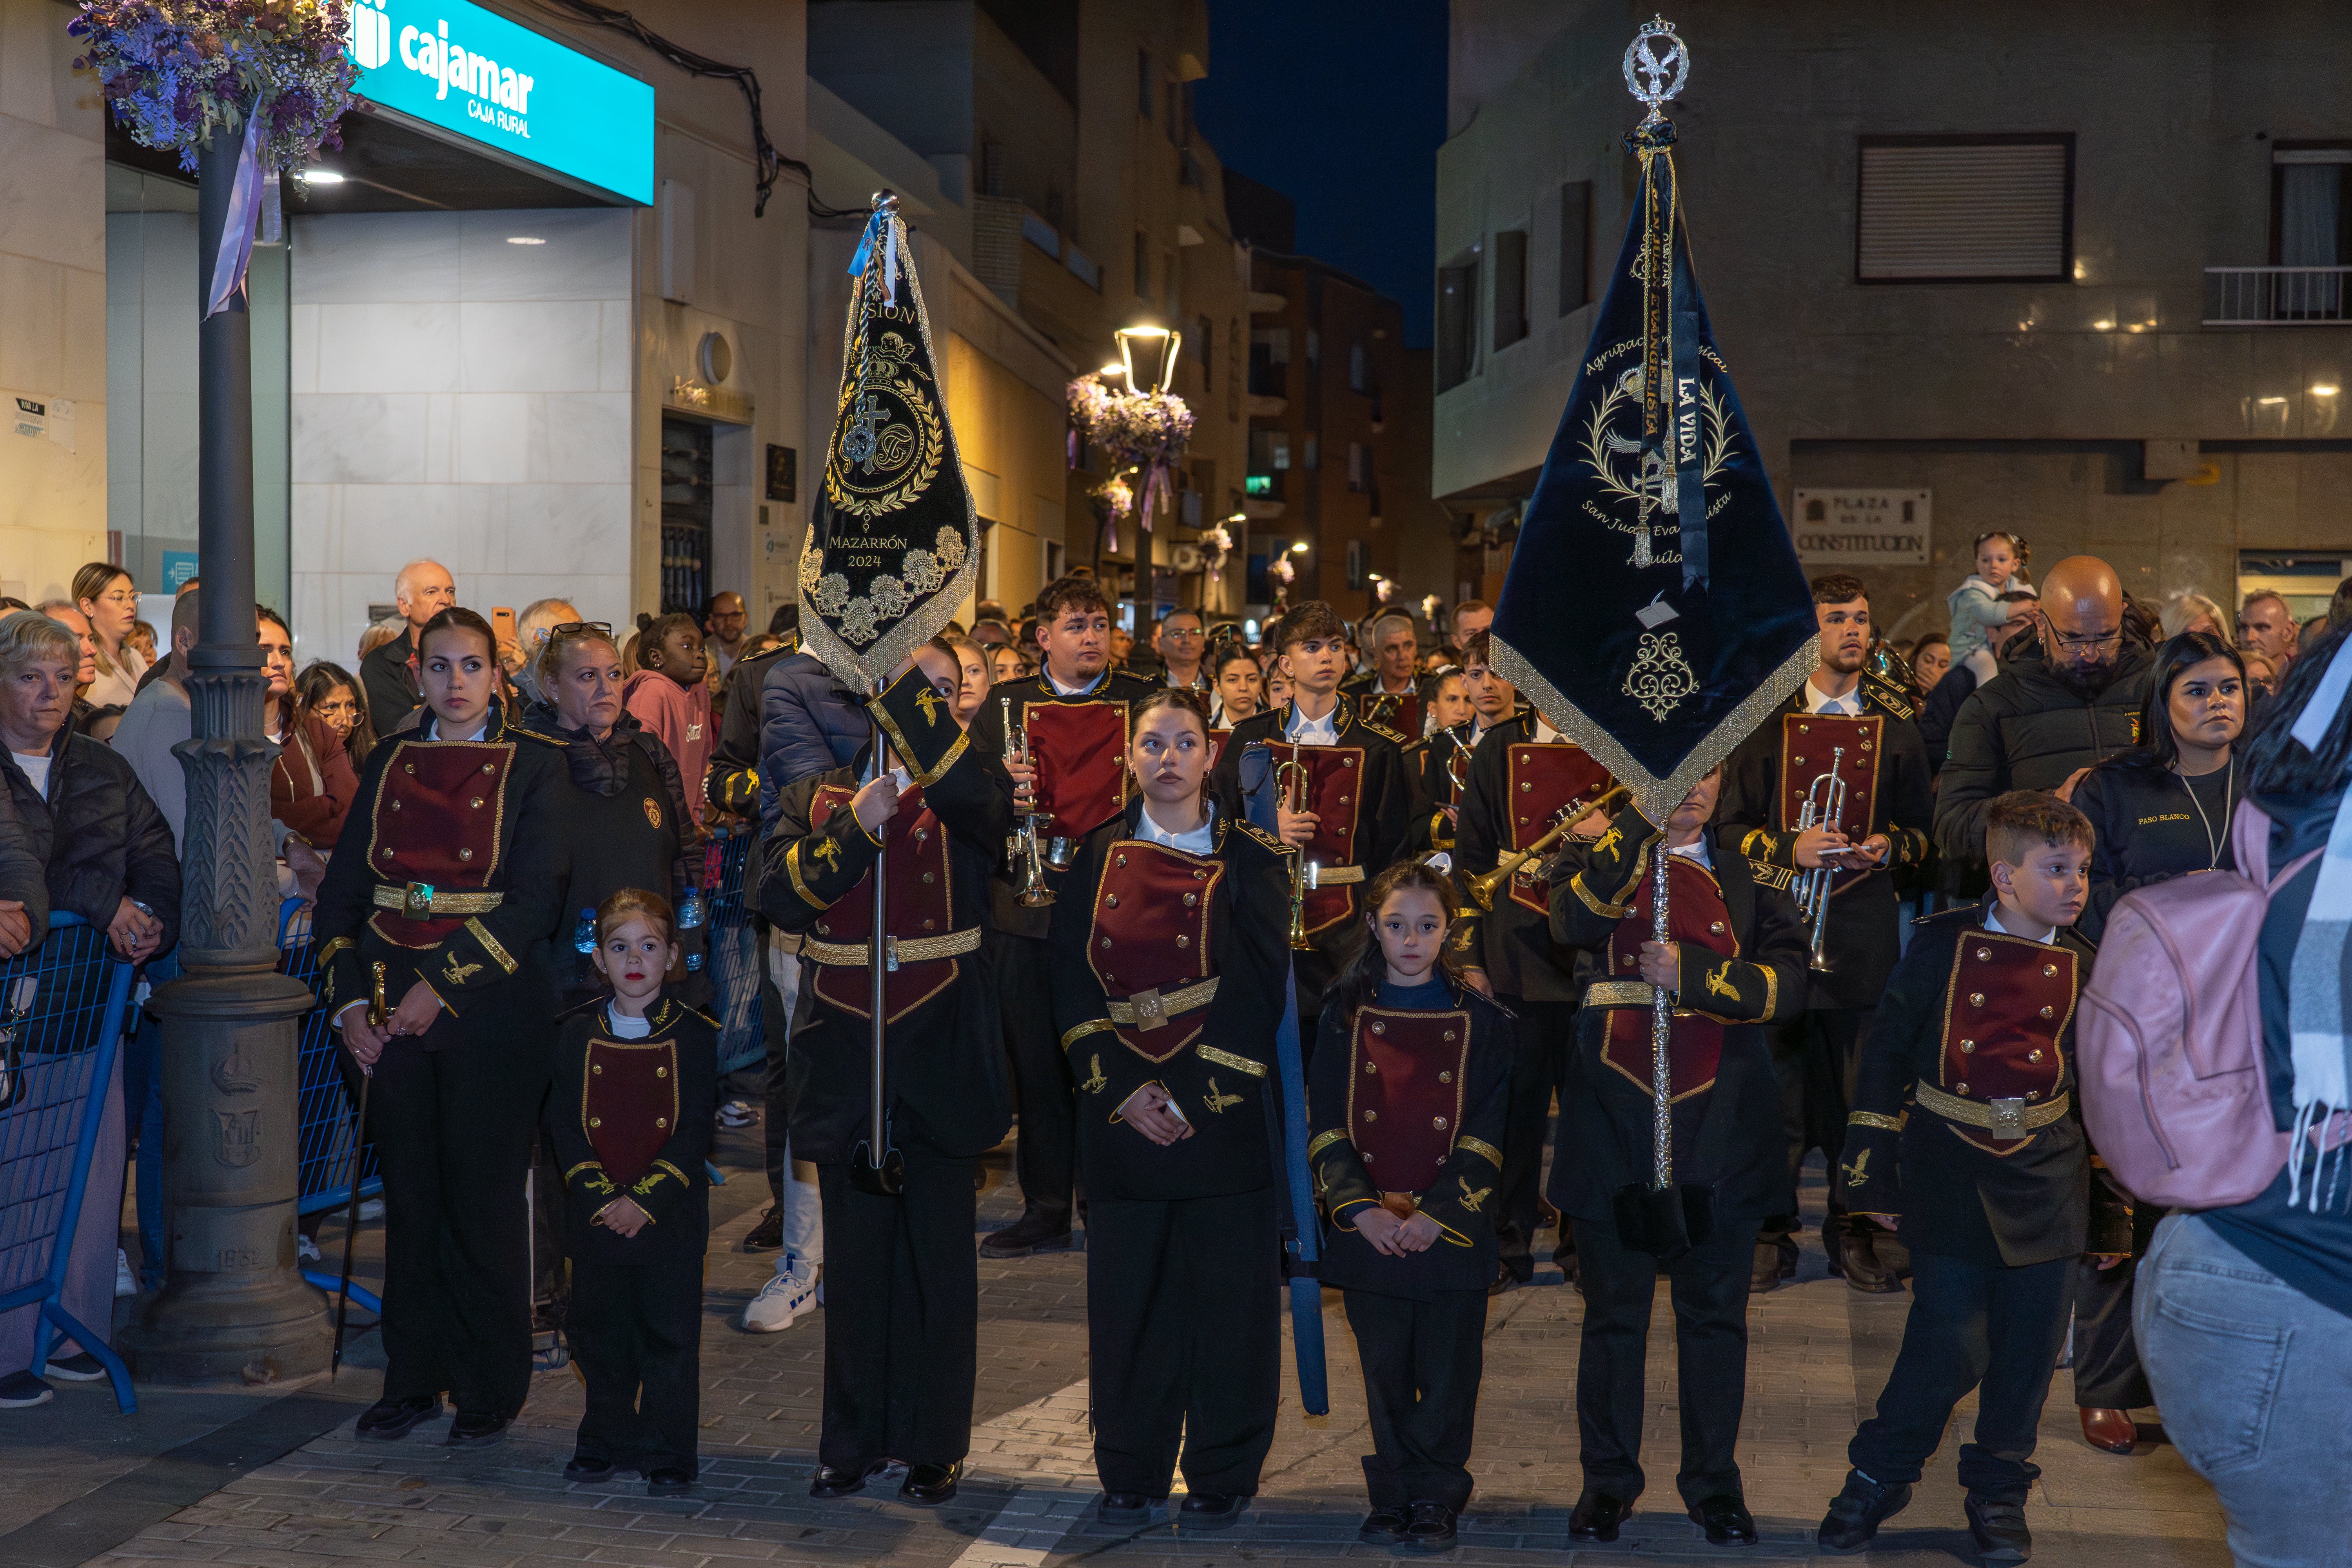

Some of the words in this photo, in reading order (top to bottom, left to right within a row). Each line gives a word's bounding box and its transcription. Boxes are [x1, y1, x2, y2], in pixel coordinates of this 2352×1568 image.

[399, 18, 534, 114] cajamar
[468, 99, 495, 126] CAJA
[497, 110, 531, 139] RURAL
[862, 299, 915, 325] SIÓN
[1586, 335, 1669, 376] Agrupacn
[1646, 292, 1661, 436] EVANGELISTA
[21, 399, 32, 410] VIVA
[32, 403, 39, 412] LA
[1678, 377, 1695, 408] LA
[1679, 411, 1697, 464] VIDA
[1833, 496, 1889, 509] PLAZA
[1582, 500, 1610, 523] San
[1608, 517, 1638, 535] Jua
[1841, 515, 1857, 523] DE
[1865, 515, 1881, 523] LA
[829, 534, 908, 549] MAZARRÓN
[848, 555, 882, 567] 2024
[2138, 816, 2158, 825] PASO
